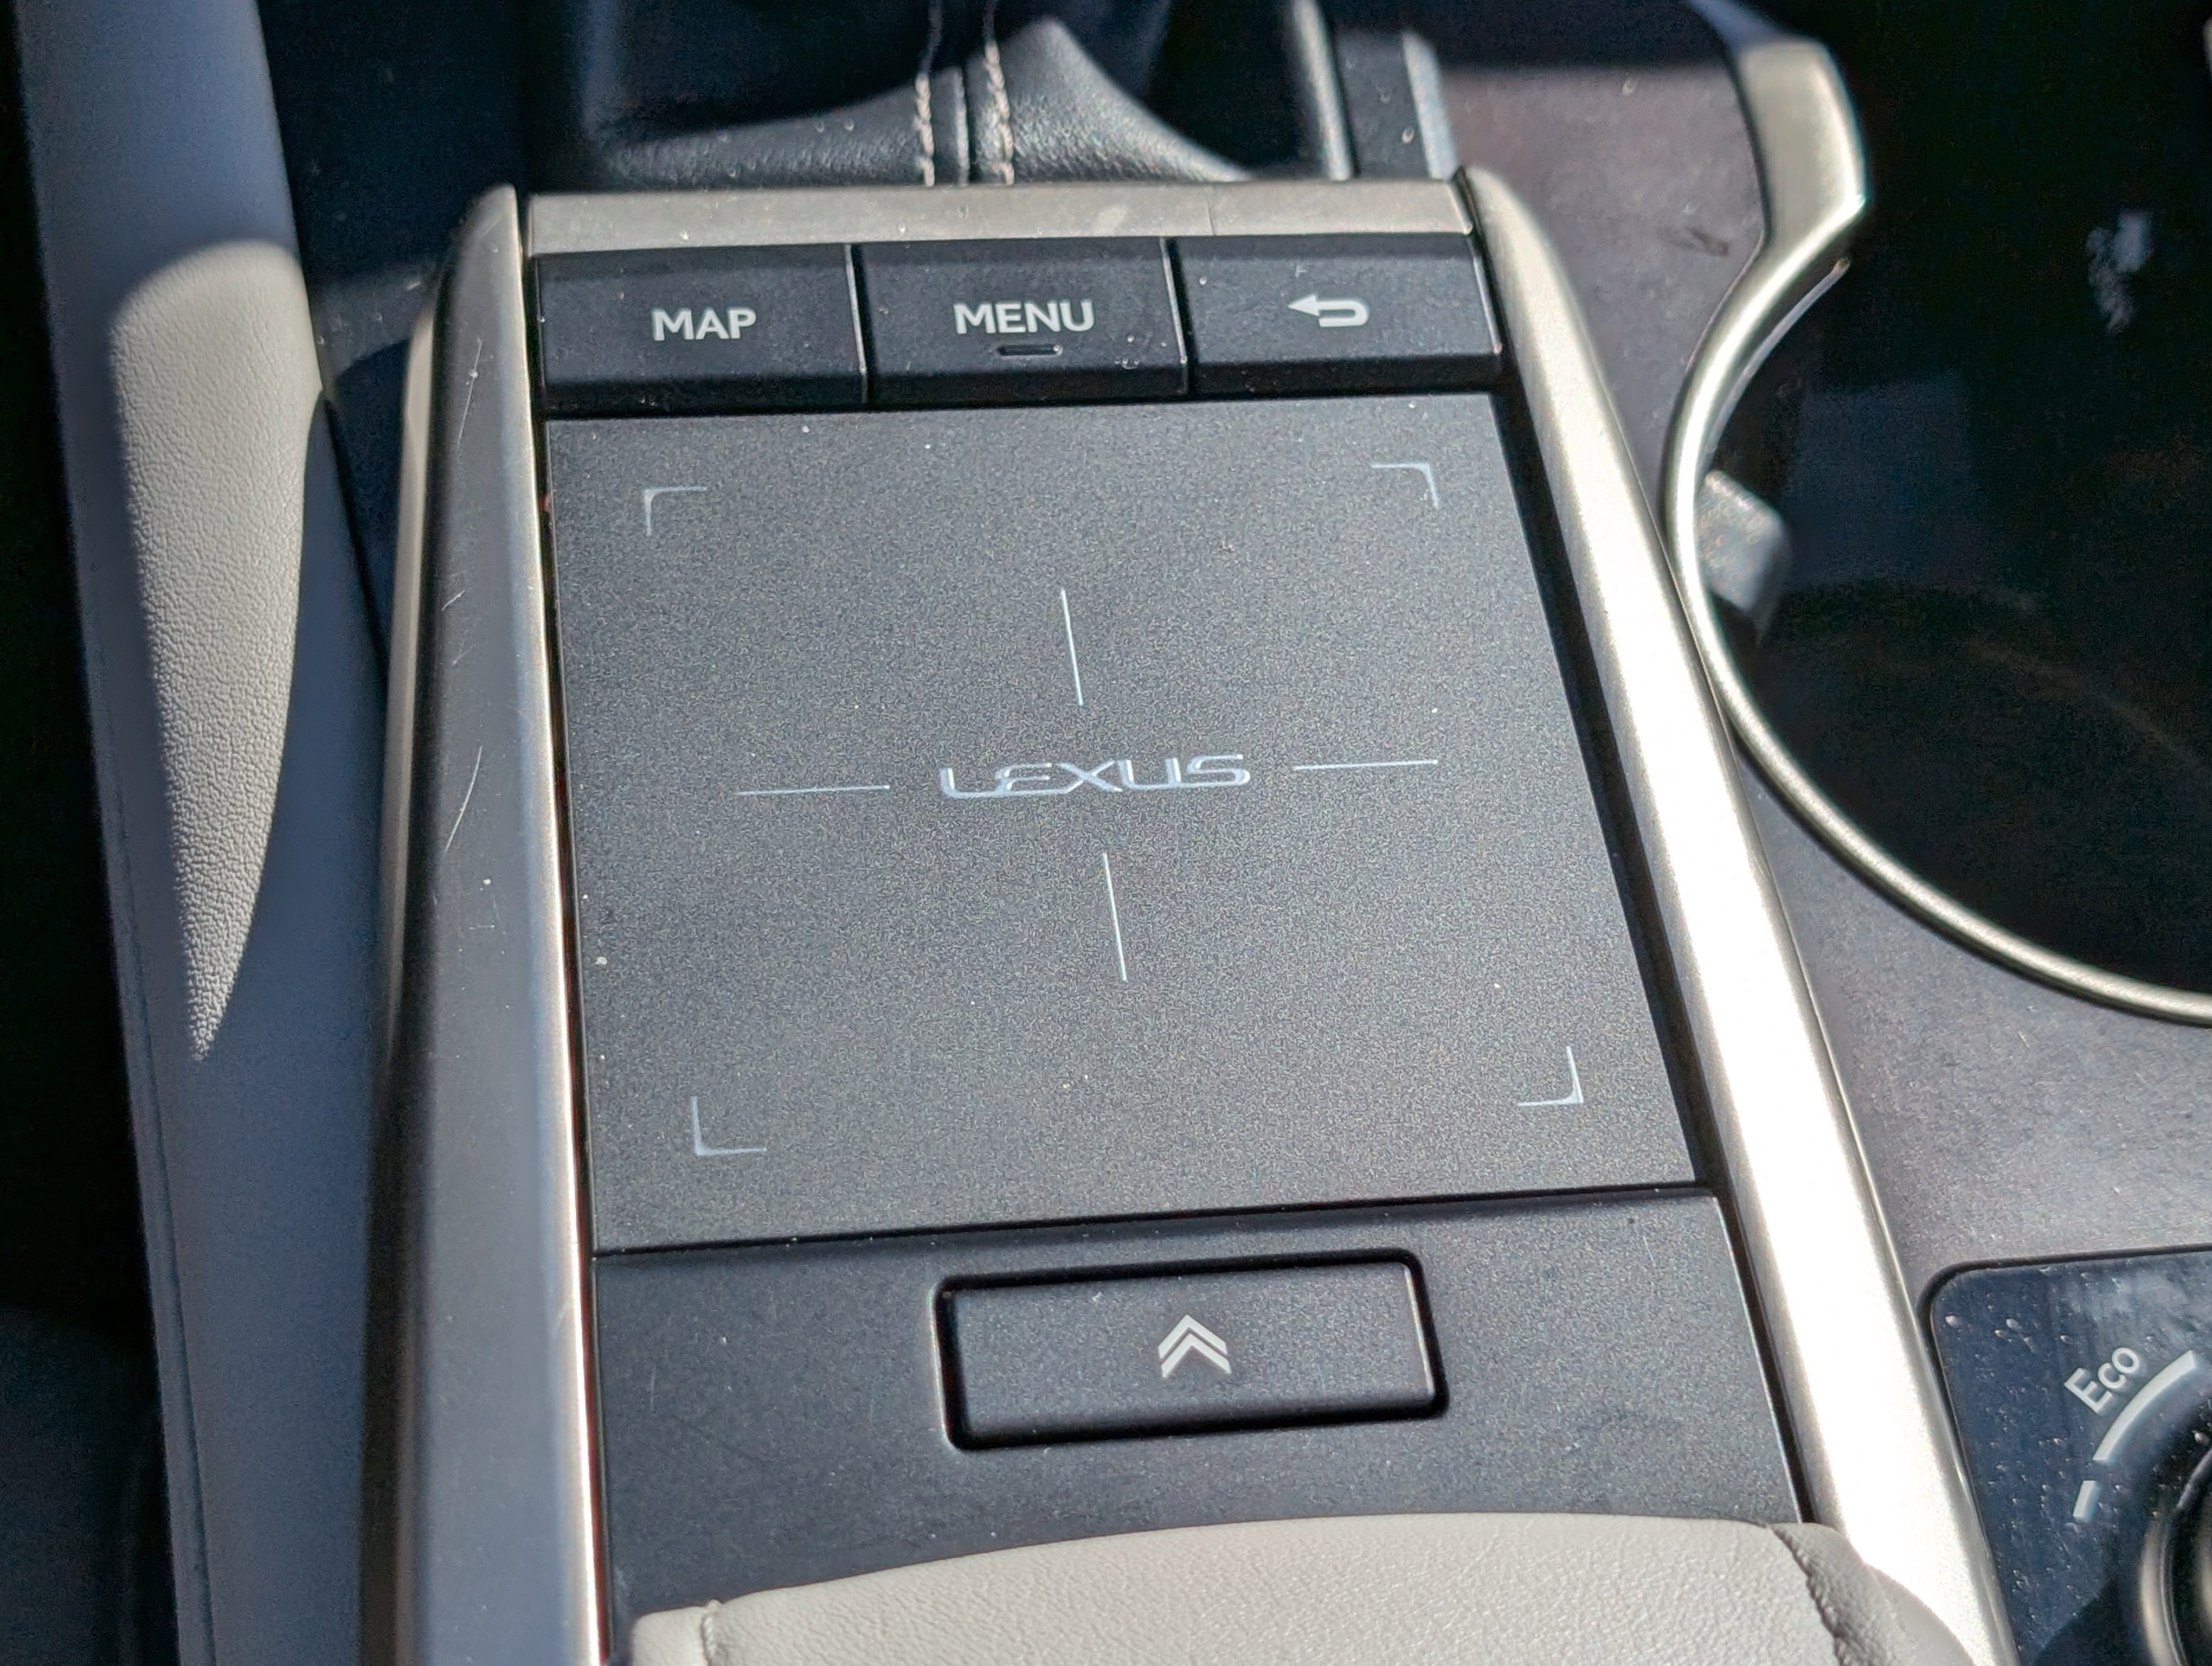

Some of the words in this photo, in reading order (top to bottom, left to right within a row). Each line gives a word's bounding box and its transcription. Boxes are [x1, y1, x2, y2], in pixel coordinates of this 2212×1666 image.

[652, 307, 757, 341] MAP
[953, 300, 1095, 334] MENU
[940, 754, 1251, 799] LEXUS
[2063, 1347, 2140, 1414] Eco
